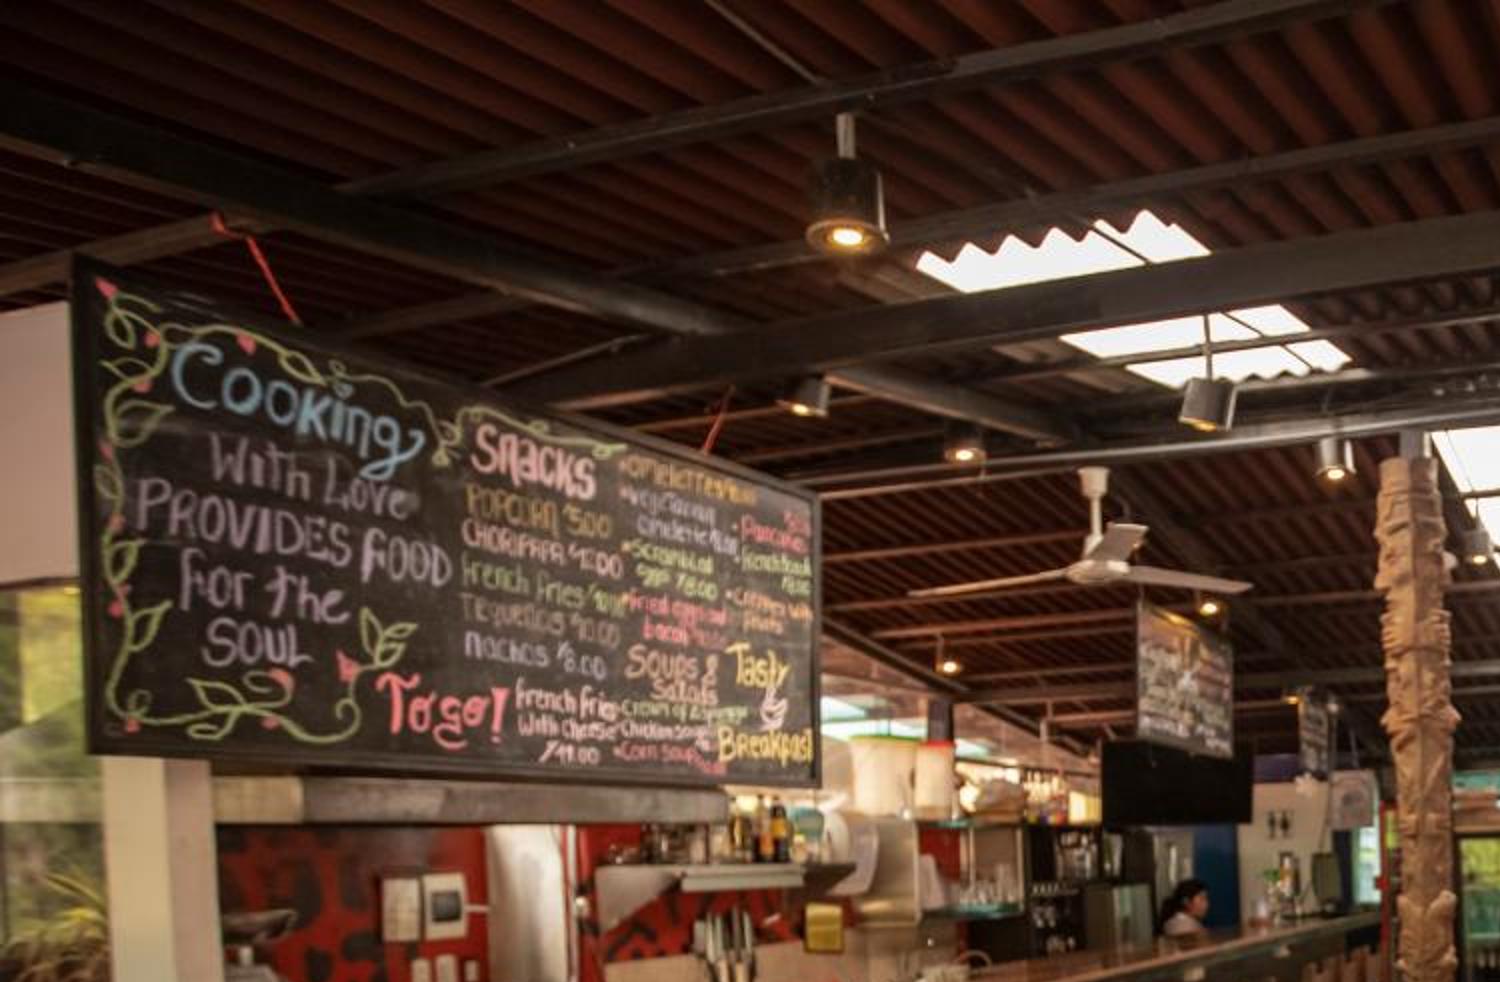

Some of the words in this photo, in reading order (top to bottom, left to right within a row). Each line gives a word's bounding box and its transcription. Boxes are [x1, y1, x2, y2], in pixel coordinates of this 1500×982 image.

[171, 343, 426, 480] Cooking
[135, 477, 353, 567] PROVIDES
[324, 457, 418, 520] Love
[724, 641, 792, 689] Tasty
